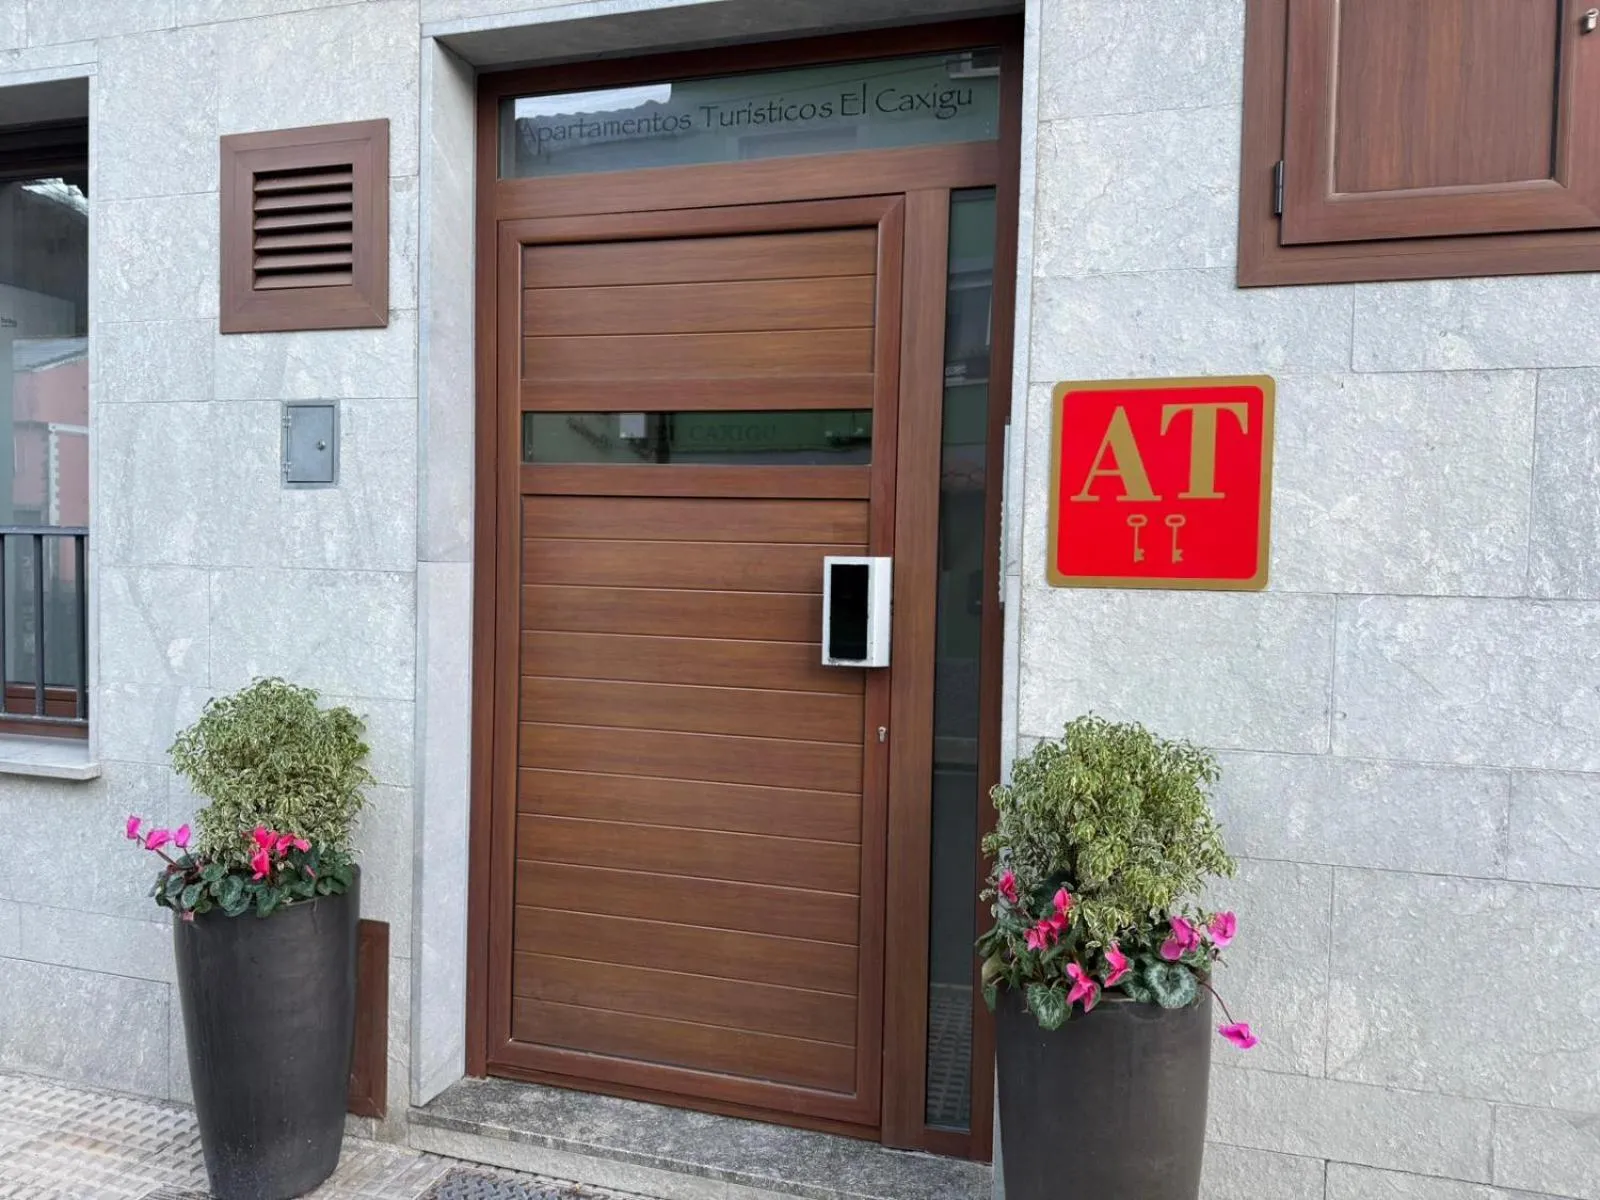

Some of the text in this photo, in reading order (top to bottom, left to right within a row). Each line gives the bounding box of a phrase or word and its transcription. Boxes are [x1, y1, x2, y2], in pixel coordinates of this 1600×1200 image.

[518, 111, 692, 155] Apartamentos
[840, 82, 867, 117] El
[874, 82, 973, 120] Caxigu
[1070, 402, 1249, 502] AT
